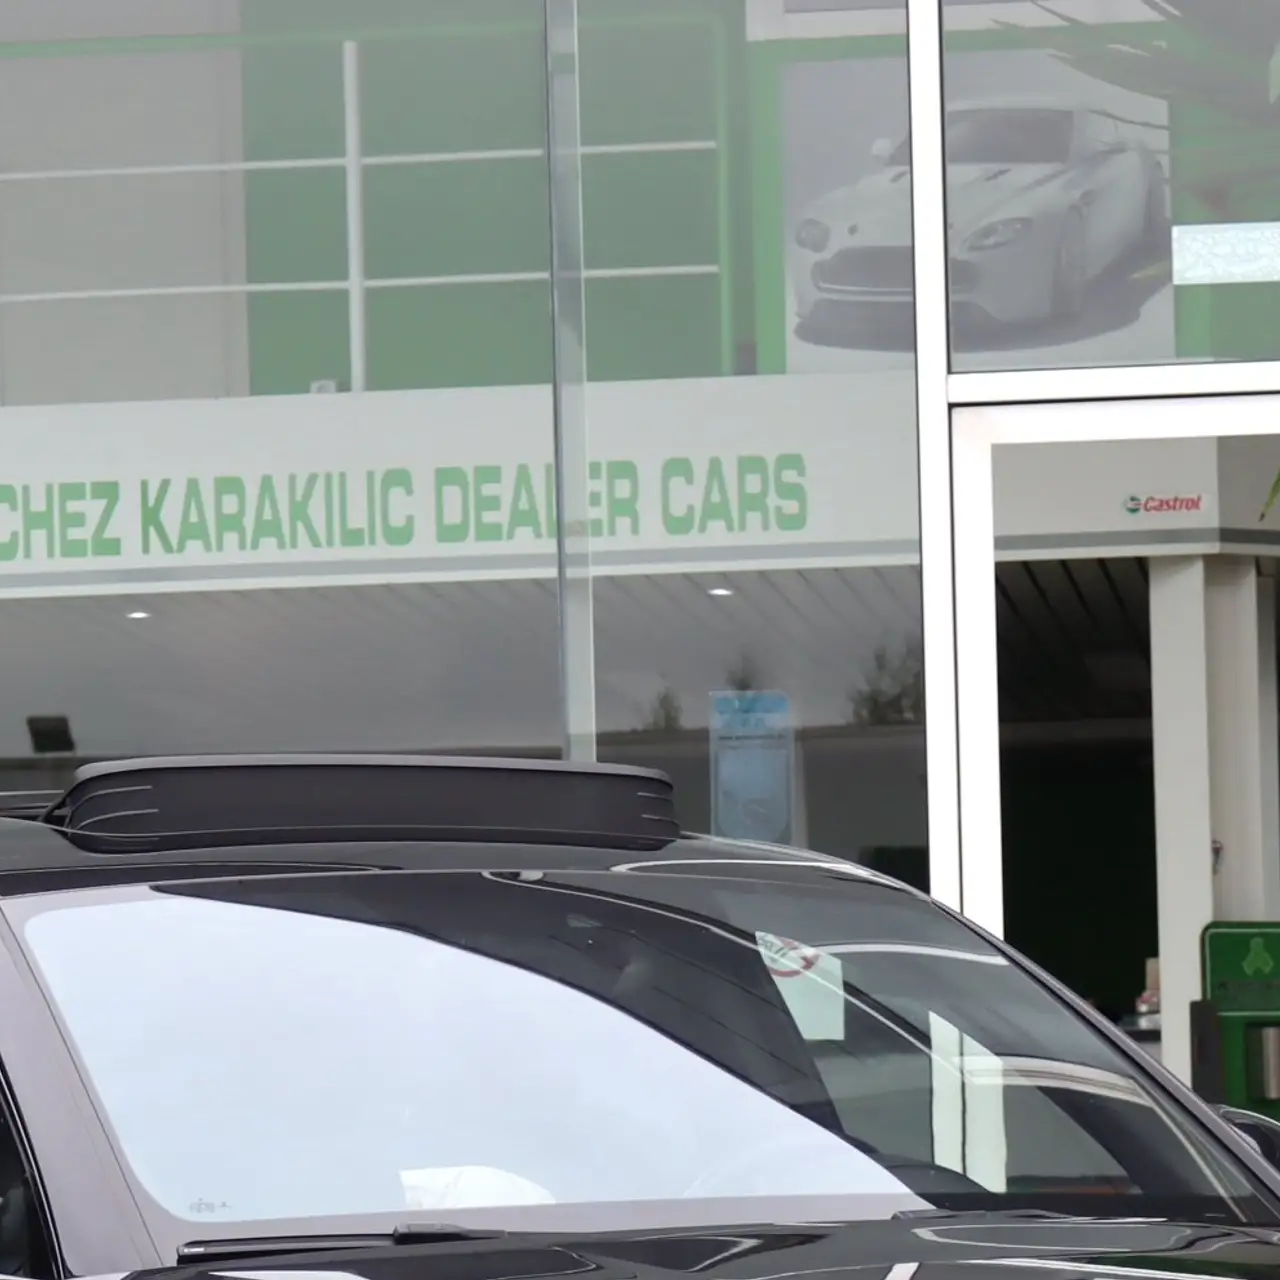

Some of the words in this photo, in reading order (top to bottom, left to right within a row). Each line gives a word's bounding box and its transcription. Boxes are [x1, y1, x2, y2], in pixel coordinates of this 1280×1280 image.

[140, 467, 415, 555] KARAKILIC
[661, 453, 809, 536] CARS
[1143, 494, 1202, 512] Castrol
